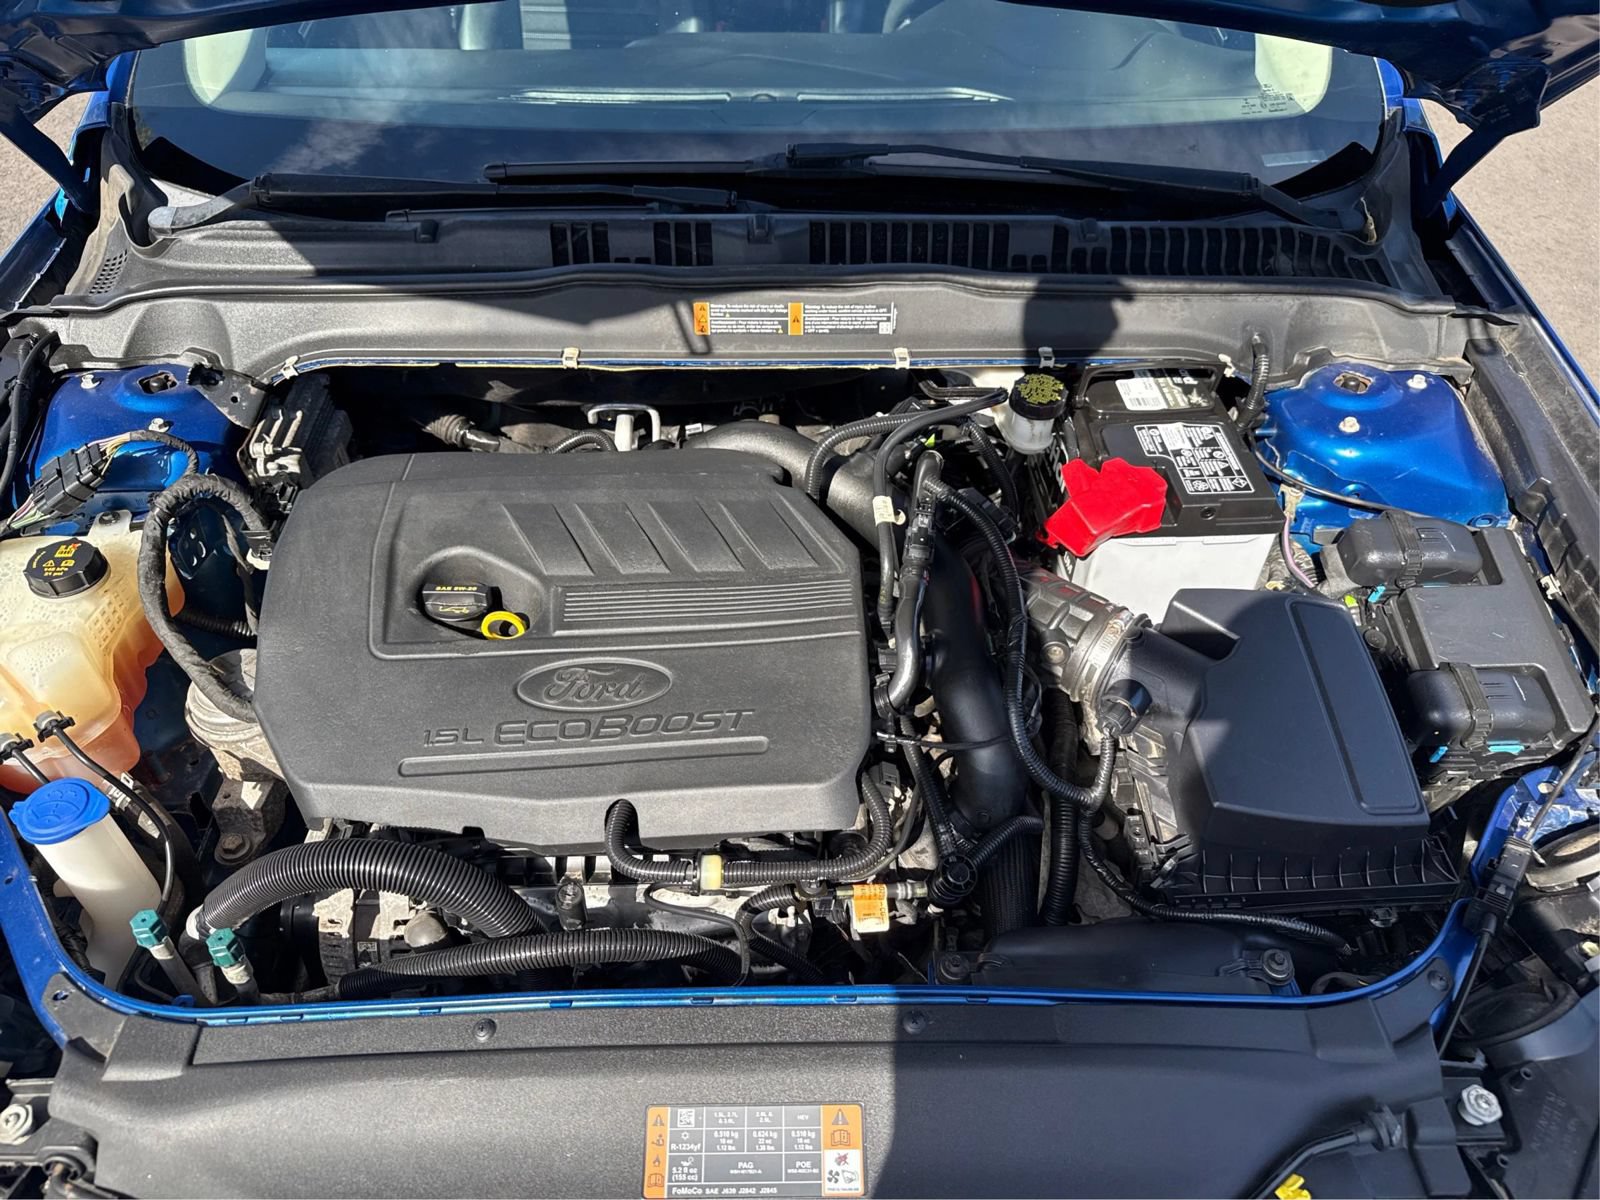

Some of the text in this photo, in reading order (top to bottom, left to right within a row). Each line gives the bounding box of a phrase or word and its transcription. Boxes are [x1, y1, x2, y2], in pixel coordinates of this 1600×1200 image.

[544, 666, 643, 702] Ford
[423, 728, 484, 747] 1.5L
[731, 1131, 739, 1139] kg
[769, 1131, 778, 1139] kg
[808, 1130, 816, 1139] kg
[671, 1143, 701, 1152] R-1234yf
[672, 1174, 687, 1182] (155
[672, 1187, 703, 1195] FoMoCo
